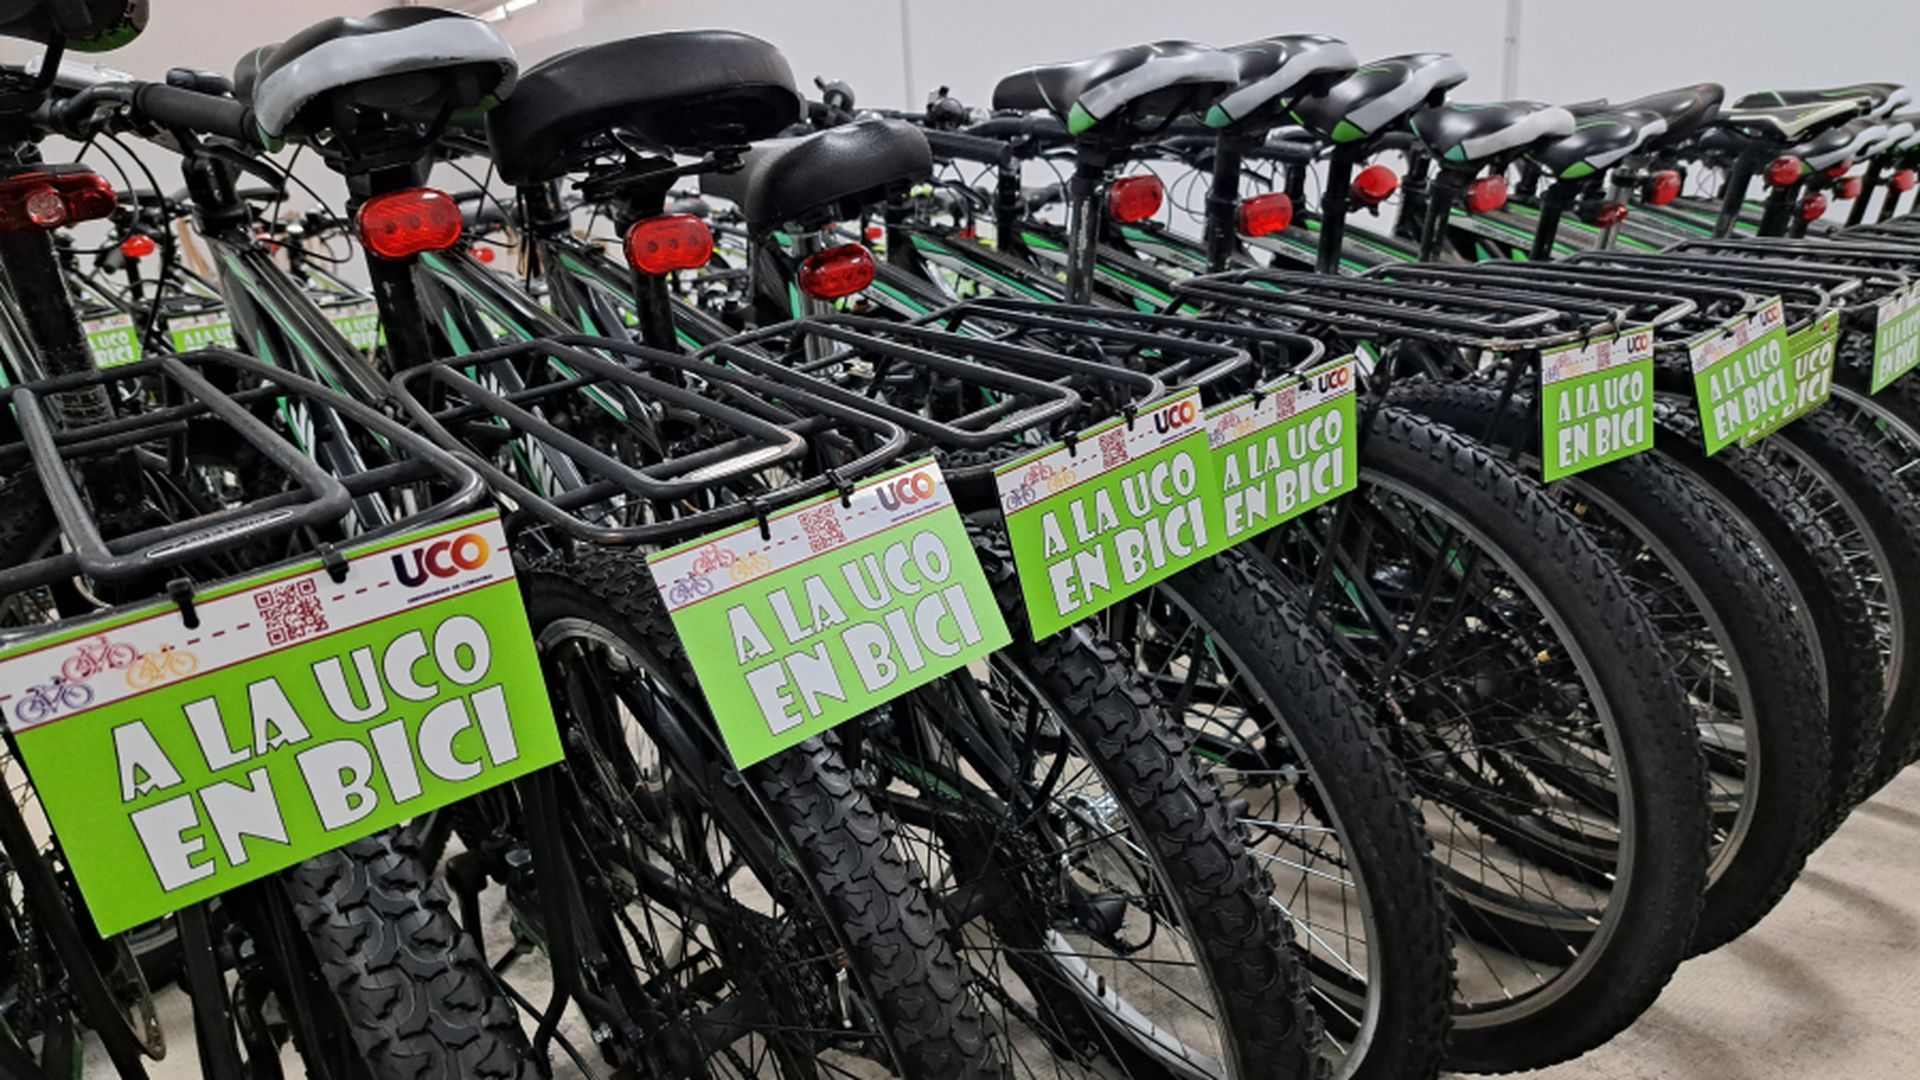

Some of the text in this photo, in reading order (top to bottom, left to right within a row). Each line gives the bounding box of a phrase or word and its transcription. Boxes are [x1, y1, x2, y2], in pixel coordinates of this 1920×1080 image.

[1627, 333, 1649, 353] UCO
[1709, 339, 1781, 404] A LA UCO
[1795, 342, 1832, 380] UCO
[1318, 366, 1351, 394] UCO
[1557, 369, 1645, 424] A LA UCO
[1713, 402, 1741, 441] EN
[1742, 372, 1787, 423] BICI
[1153, 400, 1196, 435] UCO
[1223, 453, 1240, 491] A
[1247, 436, 1280, 481] LA
[1287, 408, 1343, 462] UCO
[1557, 405, 1645, 470] EN BICI
[875, 472, 936, 511] UCO
[1042, 450, 1197, 560] A LA UCO
[1224, 443, 1345, 540] EN BICI
[391, 533, 490, 588] UCO
[1047, 496, 1208, 617] EN BICI
[727, 530, 952, 666] A LA UCO
[744, 582, 984, 736] EN BICI
[112, 614, 492, 804] A LA UCO
[129, 684, 520, 894] EN BICI
